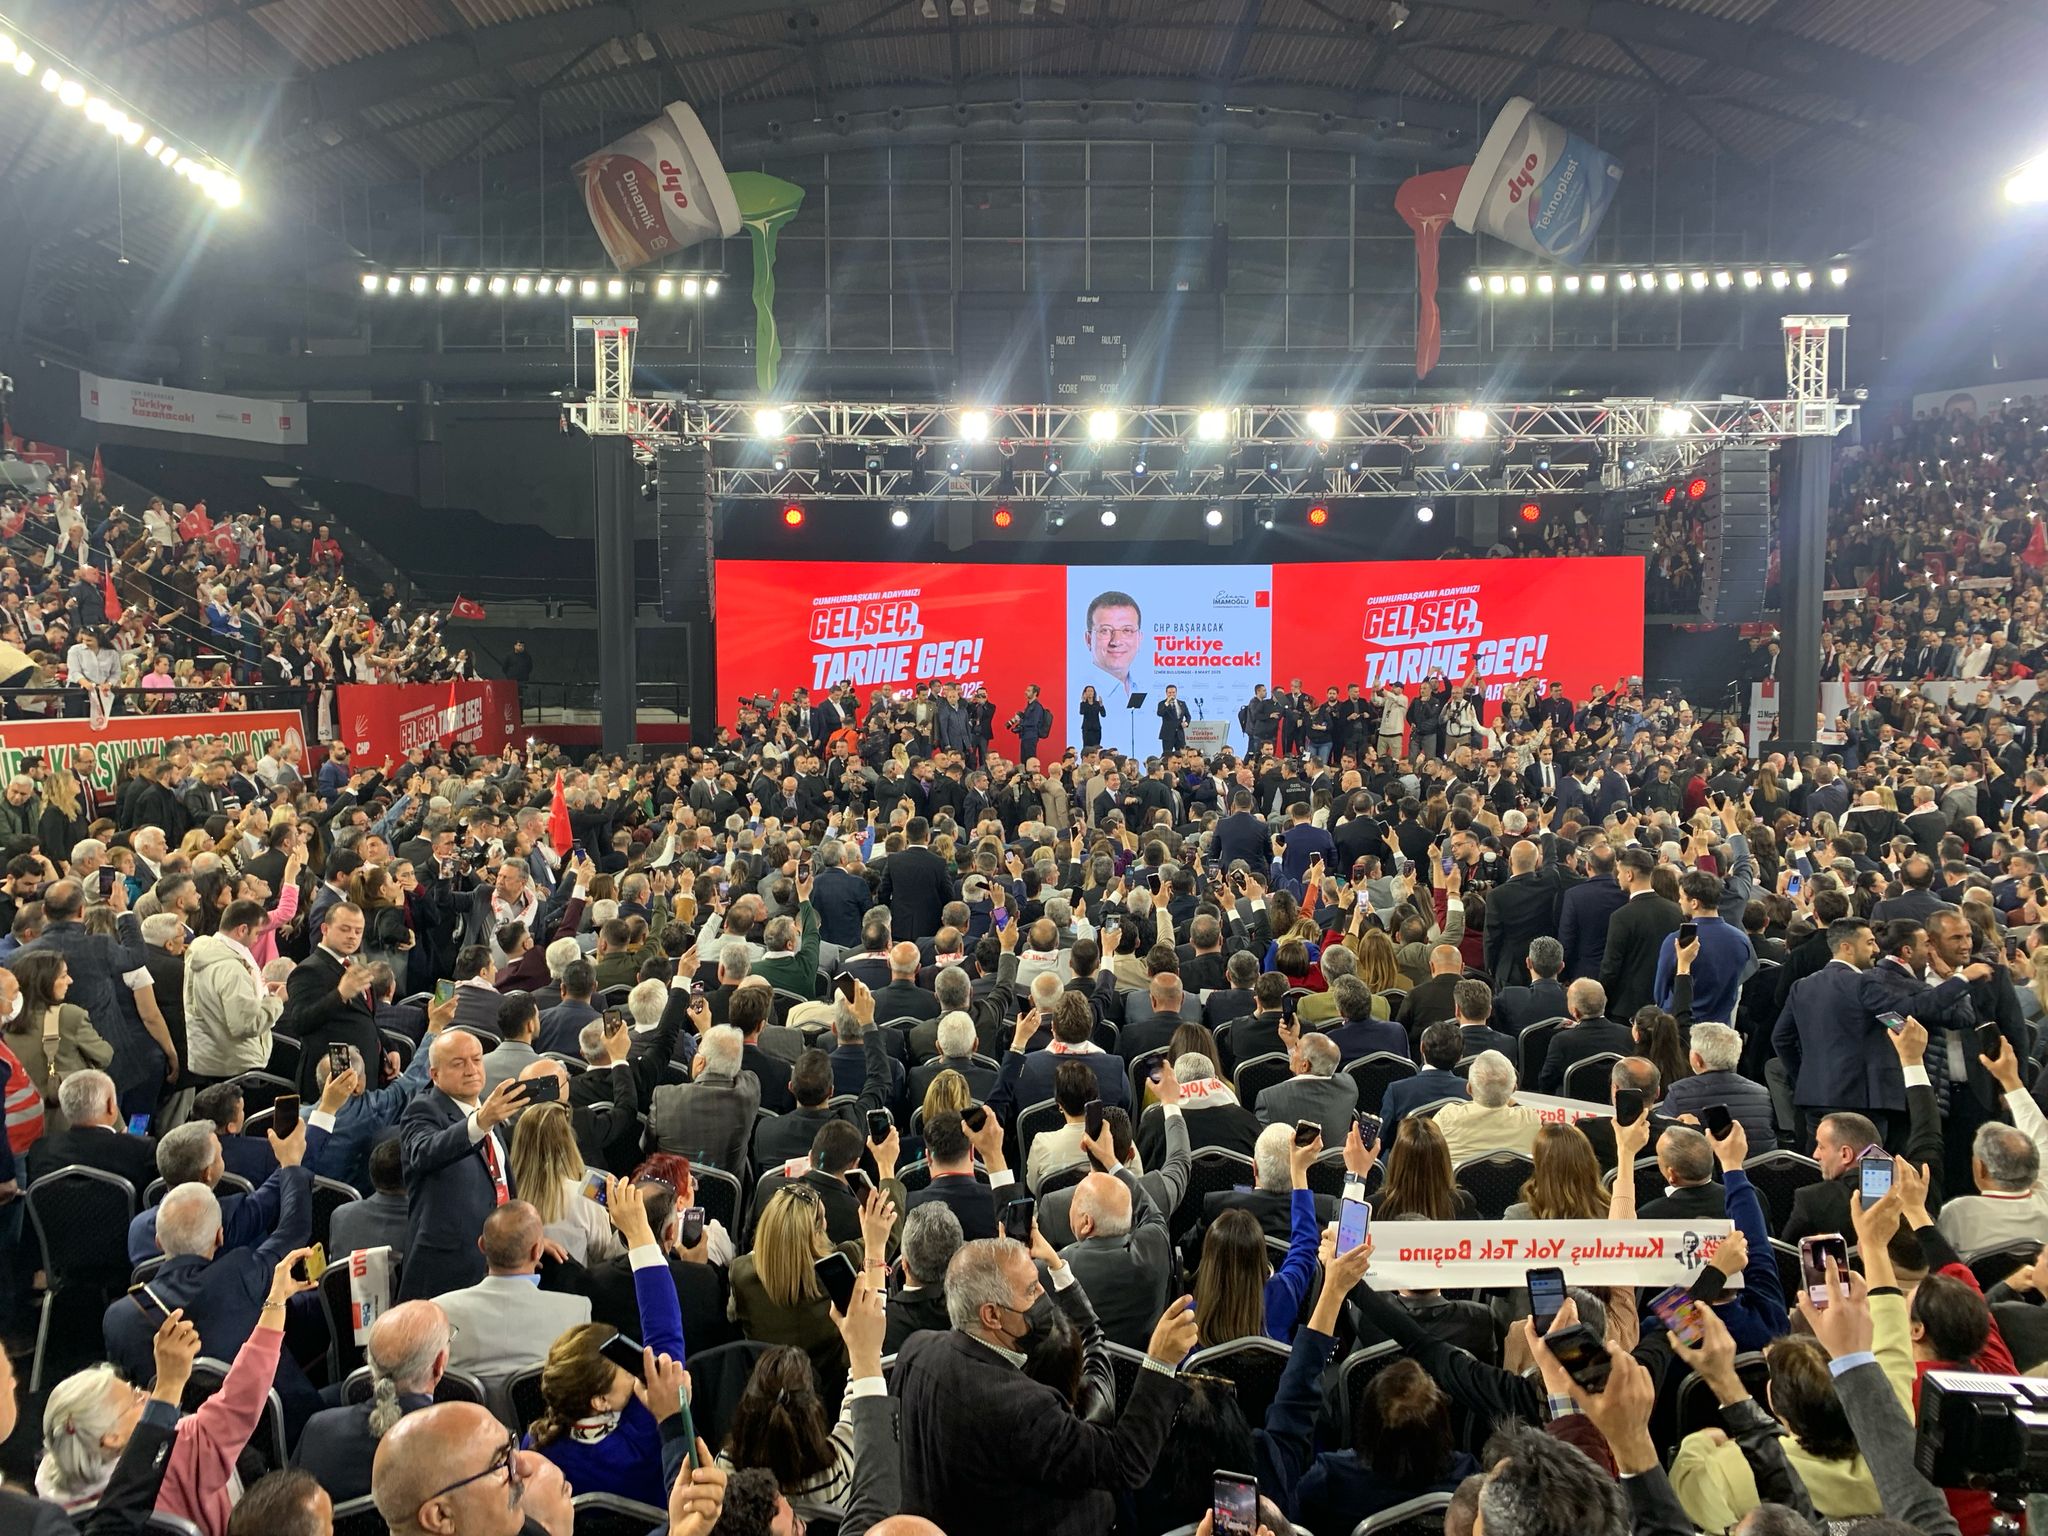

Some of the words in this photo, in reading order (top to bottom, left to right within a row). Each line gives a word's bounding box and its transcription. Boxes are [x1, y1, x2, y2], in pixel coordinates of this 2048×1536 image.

[659, 159, 689, 209] dyo
[1508, 153, 1538, 204] dyo
[622, 169, 655, 230] Dinamik
[1535, 158, 1579, 231] Teknoplast
[1058, 383, 1078, 394] SCORE
[1099, 383, 1120, 394] SCORE
[131, 396, 173, 411] Türkiye
[132, 405, 195, 423] kazanacak!
[812, 591, 881, 605] CUMHURBAŞKANI
[881, 588, 921, 599] ADAYIMIZI
[1367, 590, 1438, 605] CUMHURBAŞKANI
[1438, 584, 1481, 598] ADAYIMIZI
[1153, 623, 1171, 632] CHP
[1173, 623, 1224, 634] BAŞARACAK
[1153, 635, 1224, 655] Türkiye
[915, 638, 984, 679] GEÇ!
[1153, 651, 1261, 667] kazanacak!
[1476, 634, 1549, 677] GEÇ!
[356, 741, 371, 755] CHP
